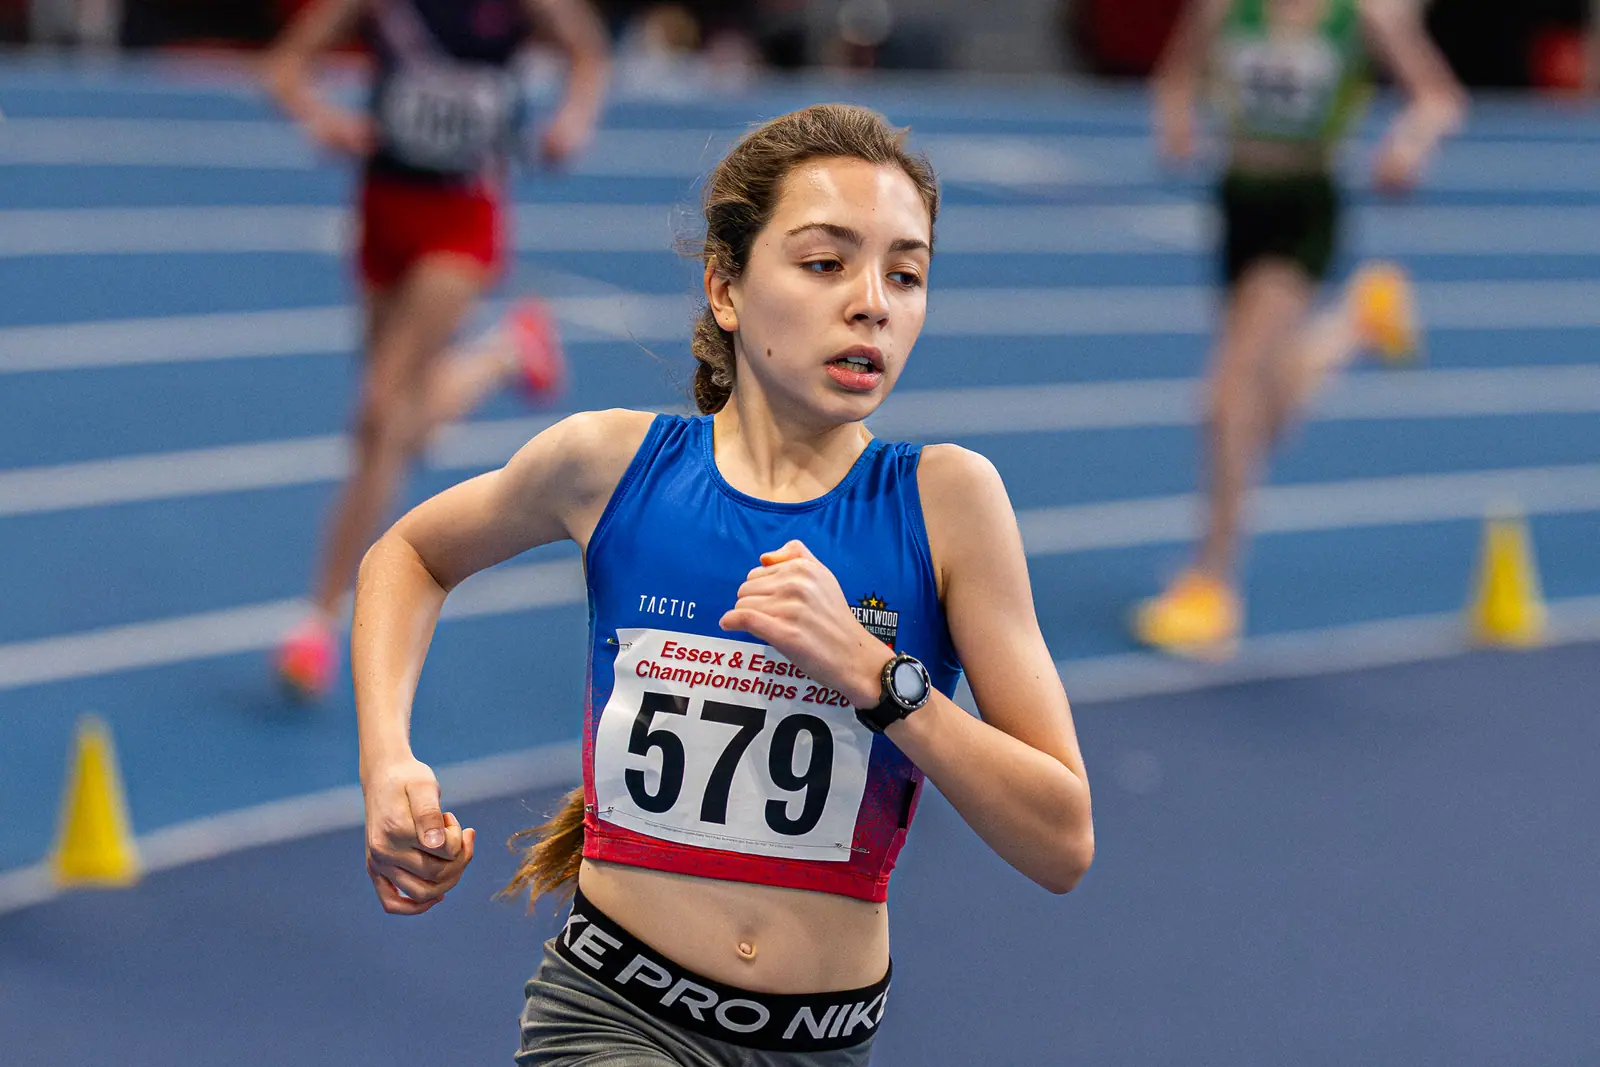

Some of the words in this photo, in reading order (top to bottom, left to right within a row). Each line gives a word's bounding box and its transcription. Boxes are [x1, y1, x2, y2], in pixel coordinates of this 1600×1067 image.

[639, 594, 696, 619] TACTIC
[635, 659, 798, 702] Championships
[660, 640, 723, 666] Essex
[728, 651, 744, 669] &
[747, 653, 811, 680] Easte
[624, 691, 834, 836] 579
[614, 953, 771, 1033] PRO
